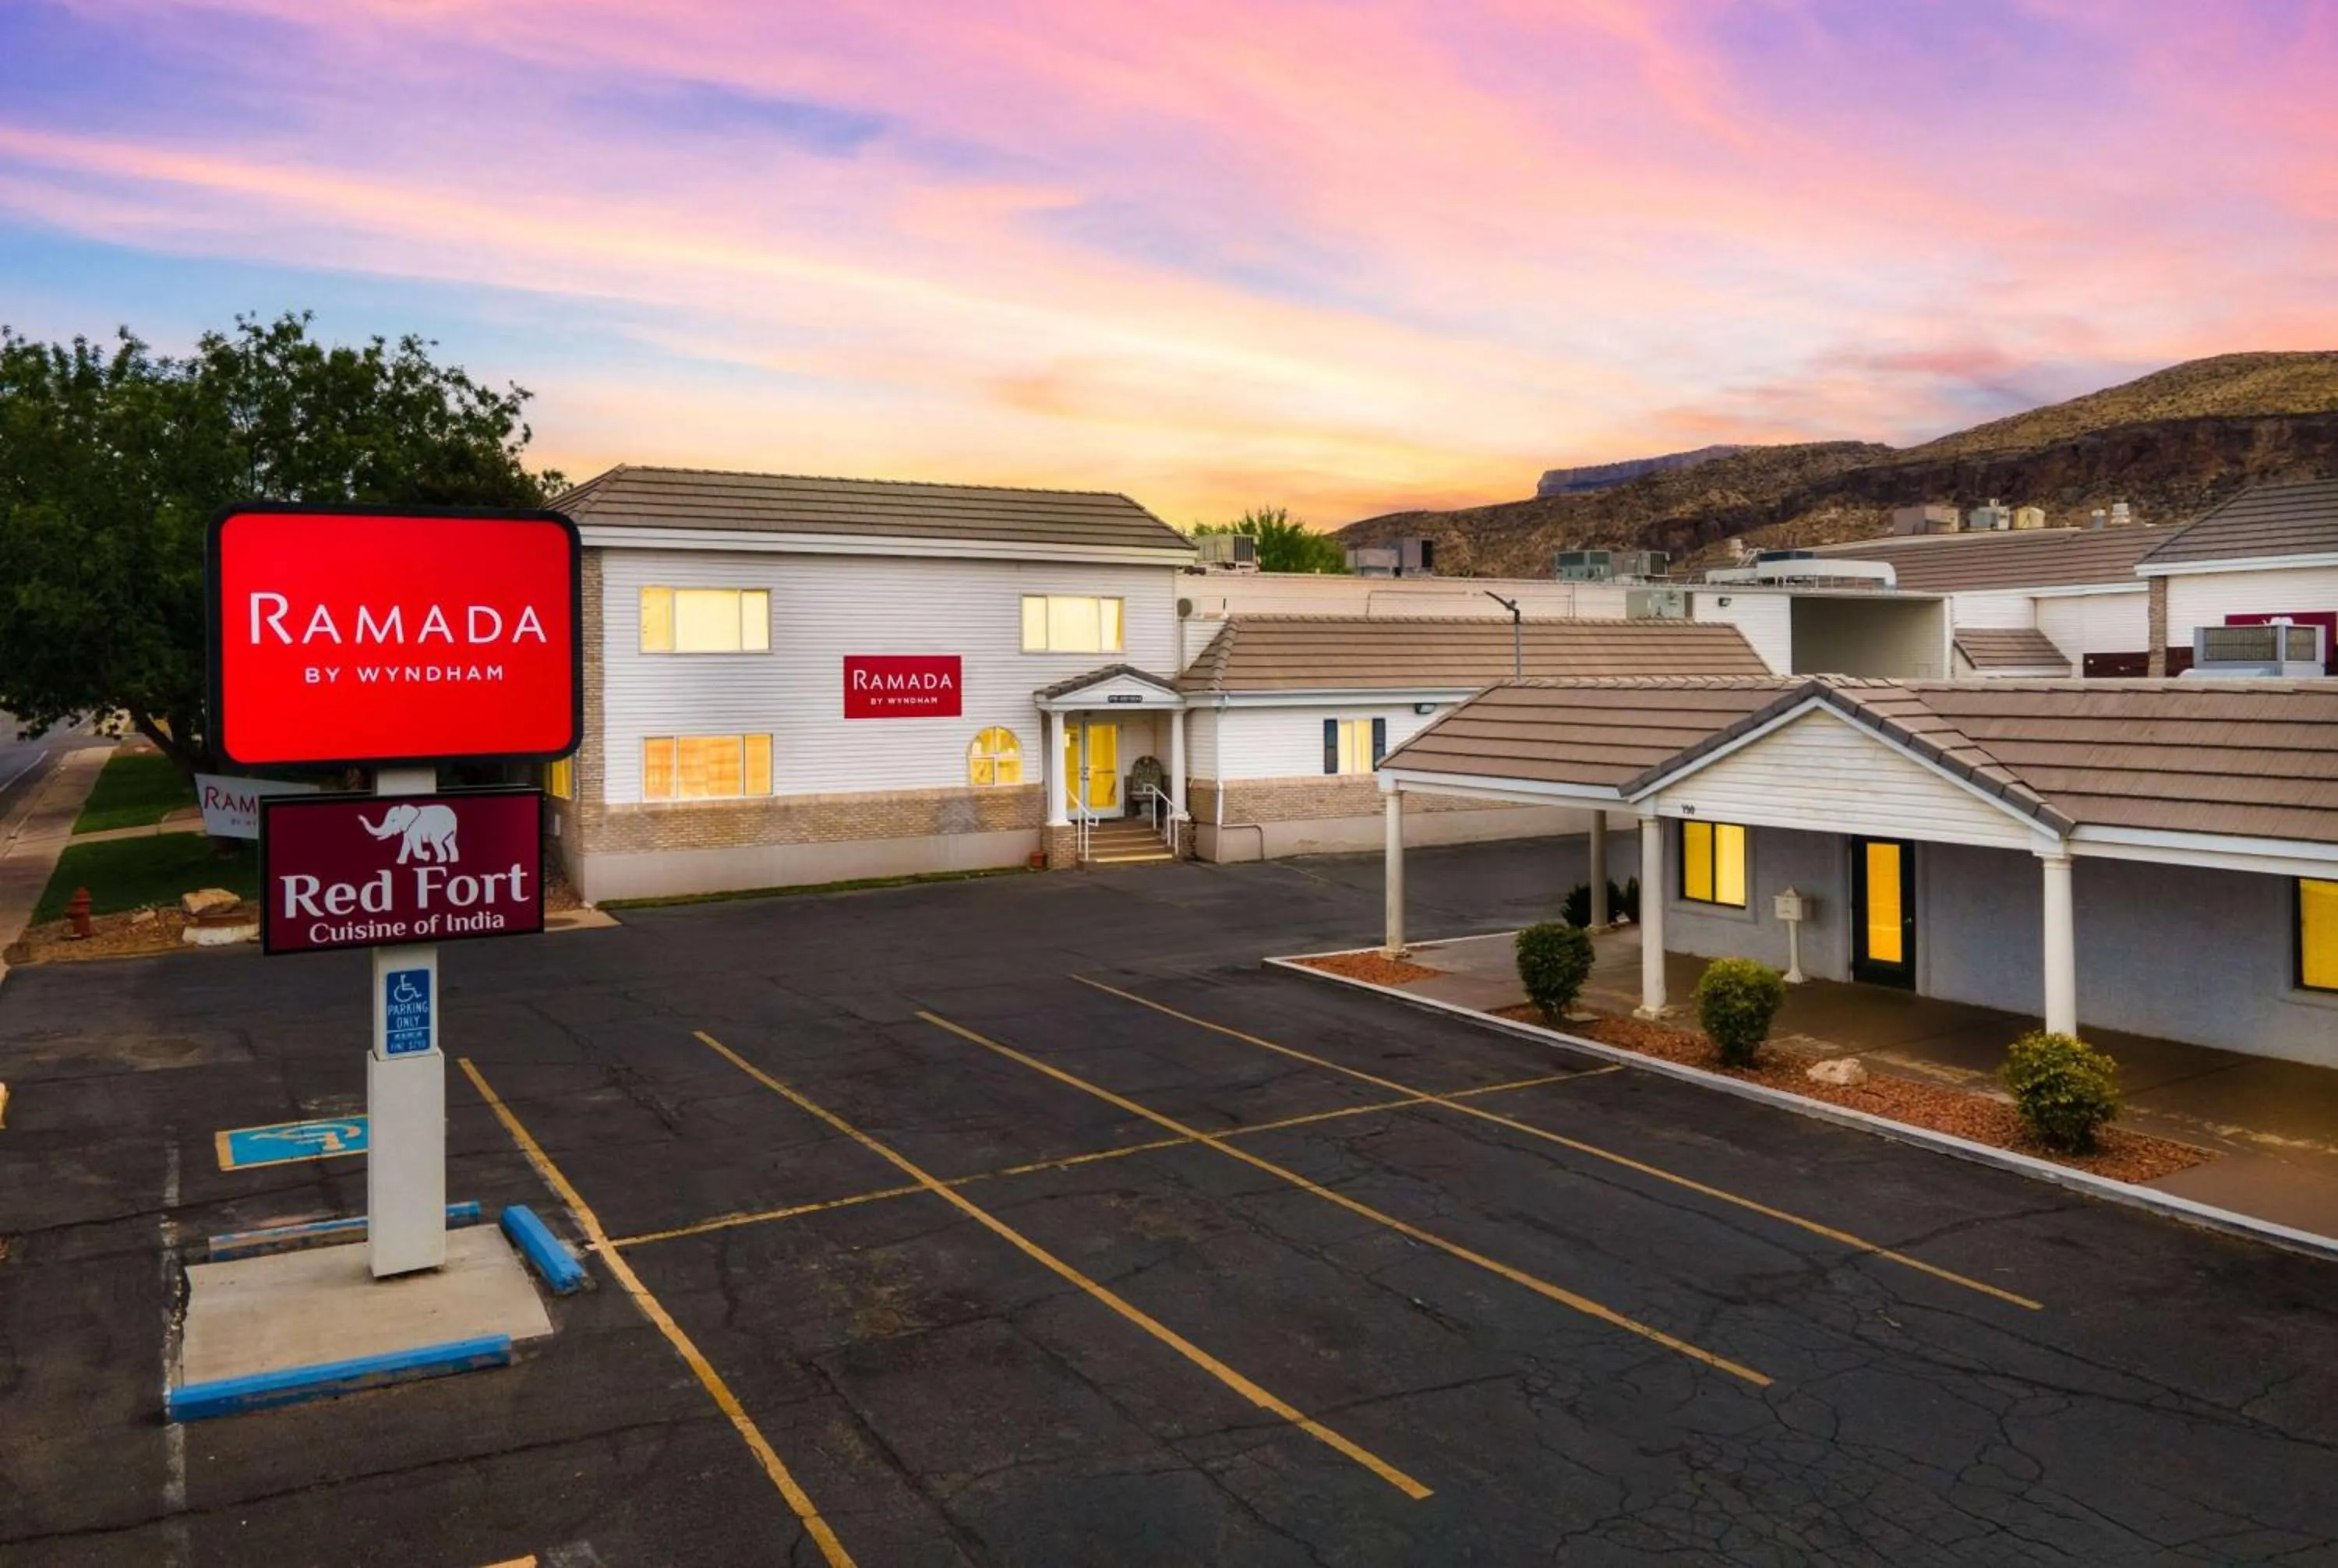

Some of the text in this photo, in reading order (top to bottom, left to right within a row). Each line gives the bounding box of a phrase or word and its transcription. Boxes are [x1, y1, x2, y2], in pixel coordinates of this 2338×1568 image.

[249, 592, 547, 645] RAMADA
[305, 665, 504, 683] BY WYNDHAM
[853, 669, 952, 690] RAMADA
[204, 786, 257, 814] RAM
[279, 863, 530, 919] Red Fort
[309, 911, 505, 944] Cuisine of India
[387, 1000, 428, 1016] PARKING
[396, 1015, 421, 1029] ONLY
